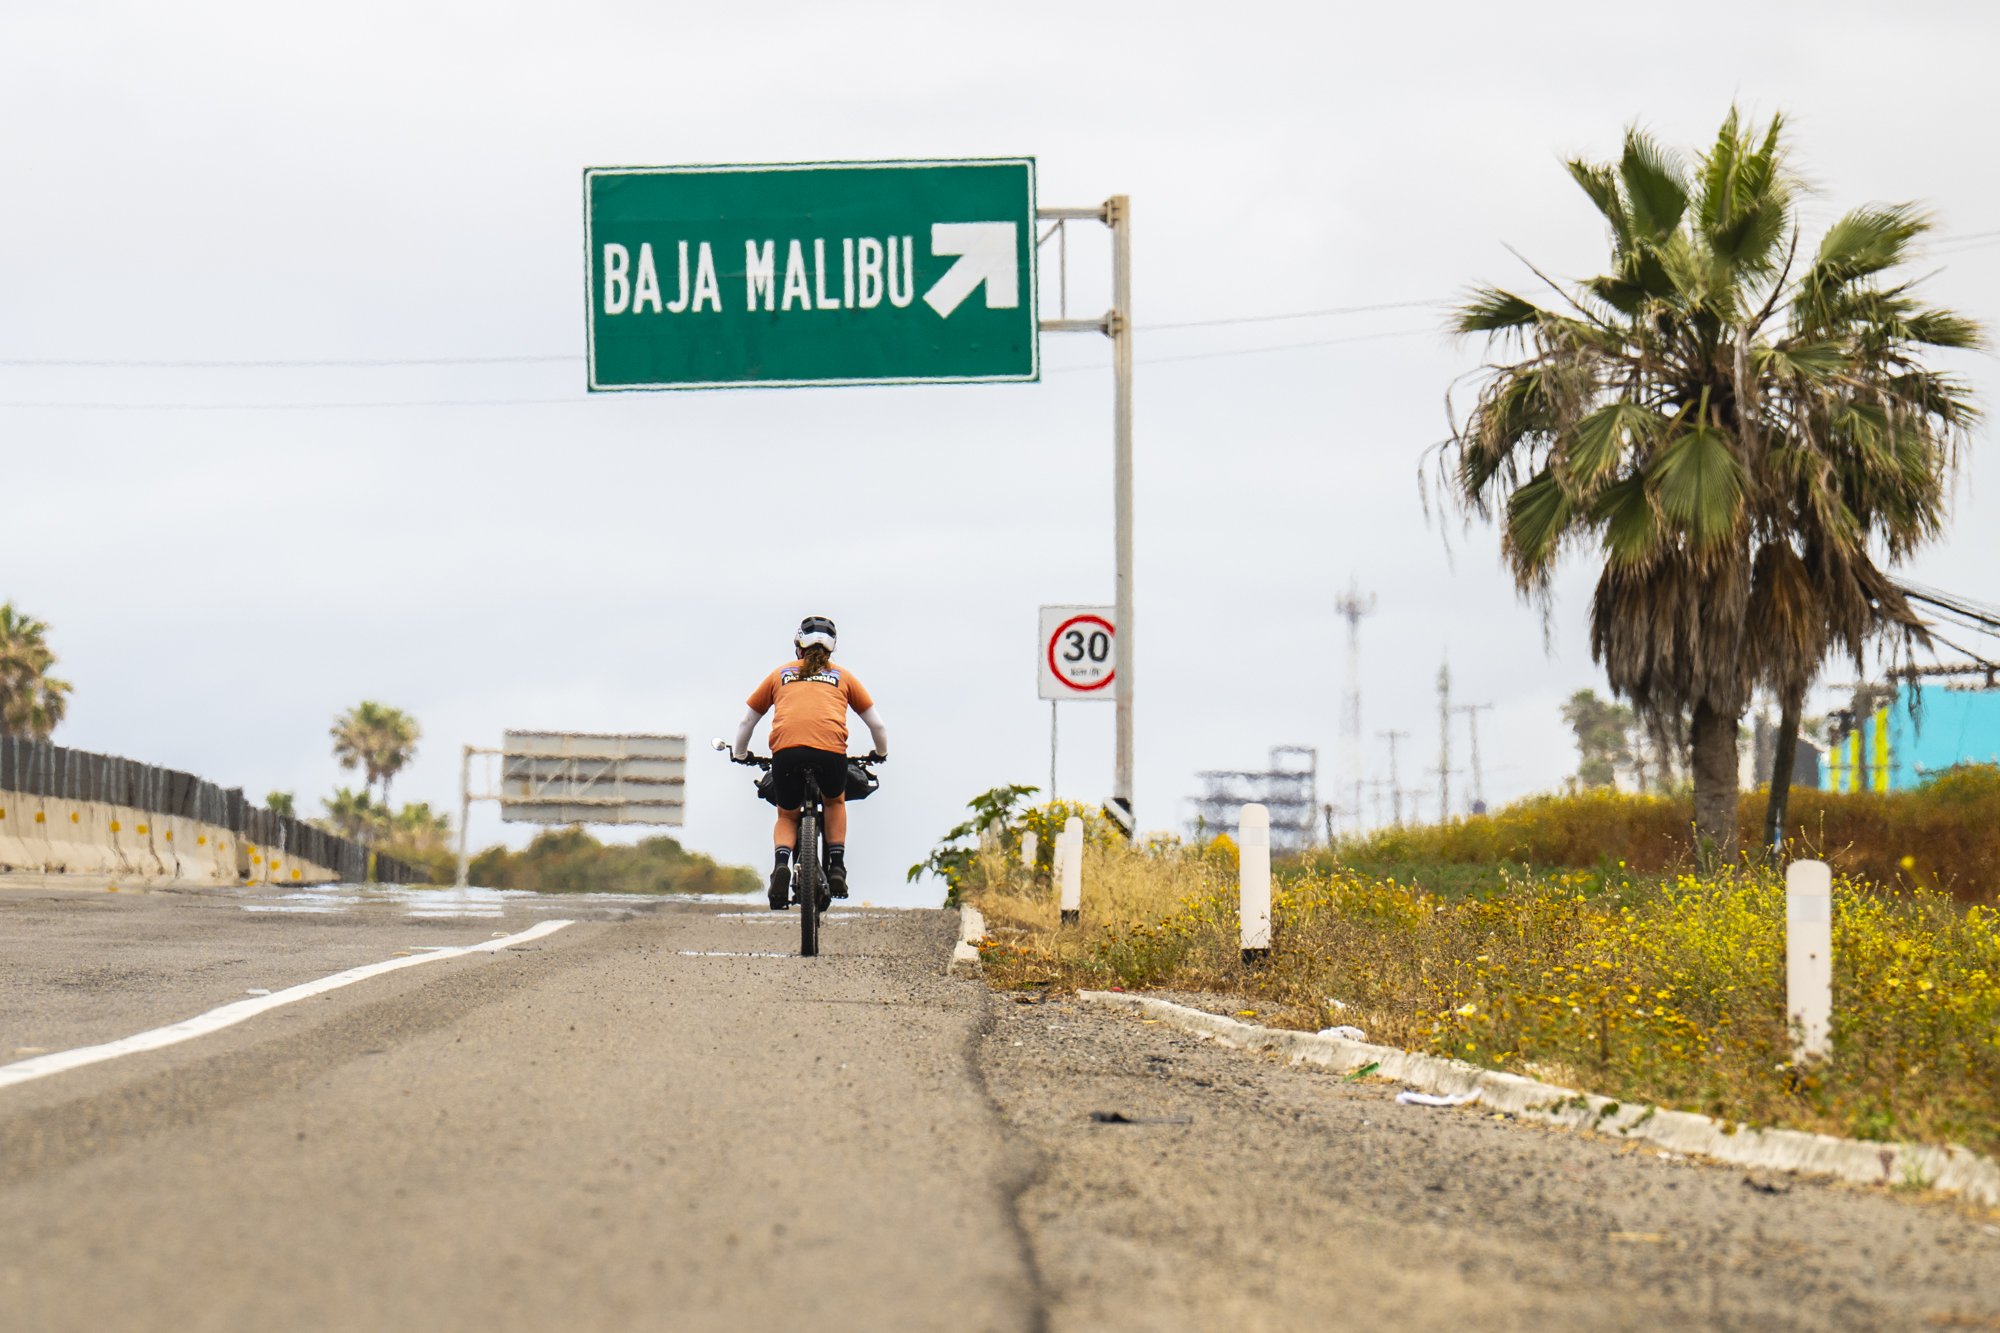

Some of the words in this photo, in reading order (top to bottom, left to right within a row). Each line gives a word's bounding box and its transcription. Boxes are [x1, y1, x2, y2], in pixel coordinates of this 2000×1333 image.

[603, 240, 722, 314] BAJA
[745, 236, 914, 312] MALIBU
[1063, 631, 1109, 662] 30
